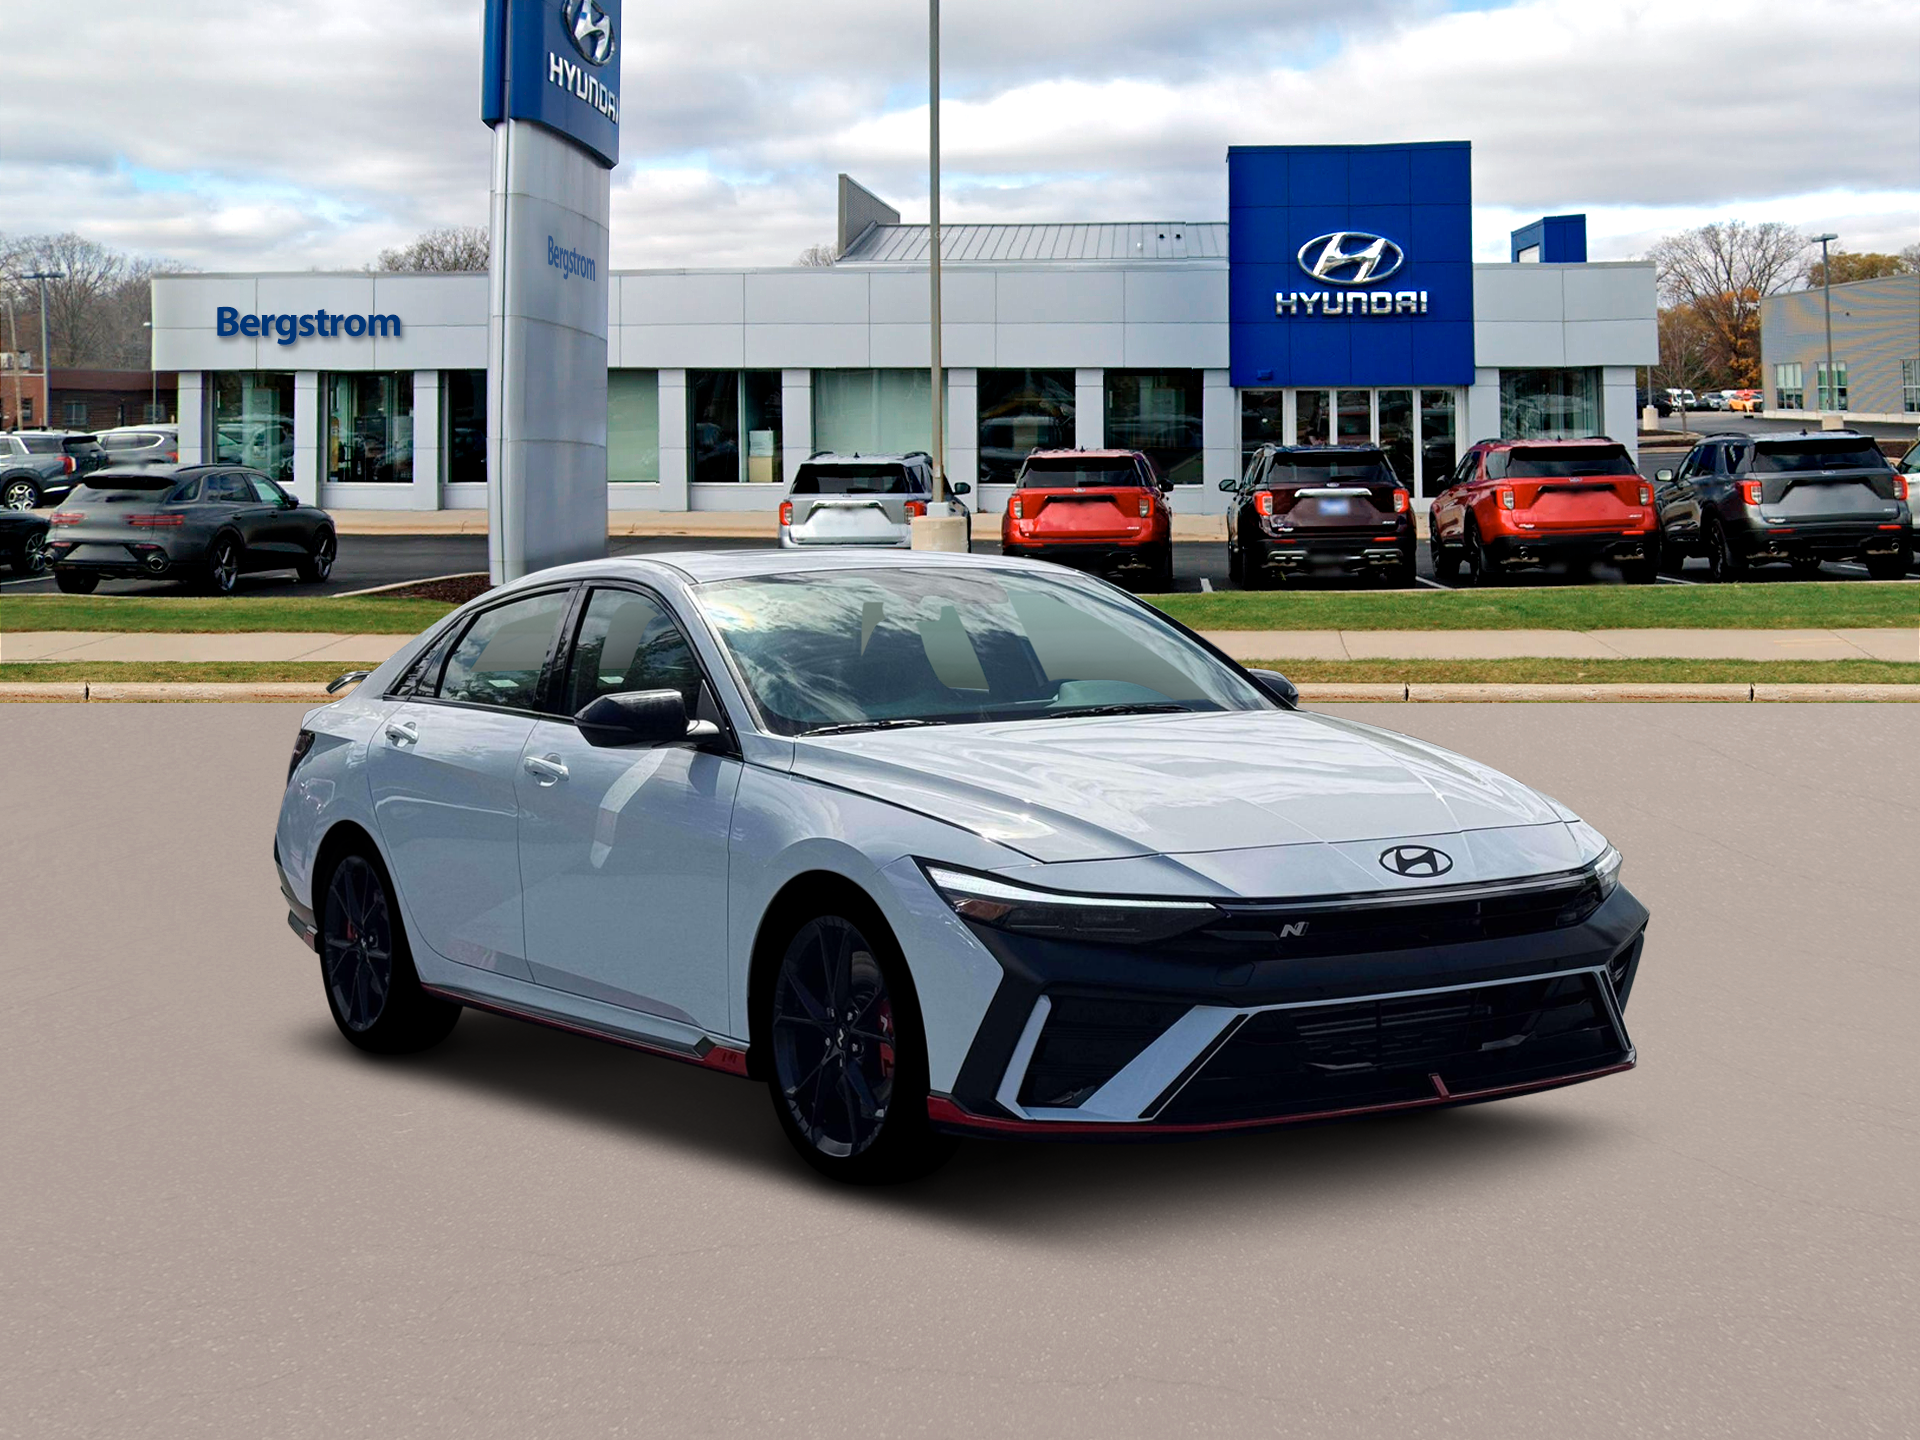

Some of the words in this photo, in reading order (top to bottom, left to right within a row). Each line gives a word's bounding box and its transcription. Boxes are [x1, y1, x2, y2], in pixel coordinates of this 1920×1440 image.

[549, 52, 619, 125] HYUNDAI
[548, 235, 596, 282] Bergstrom
[1275, 291, 1428, 315] HYUNDAI
[217, 306, 401, 346] Bergstrom
